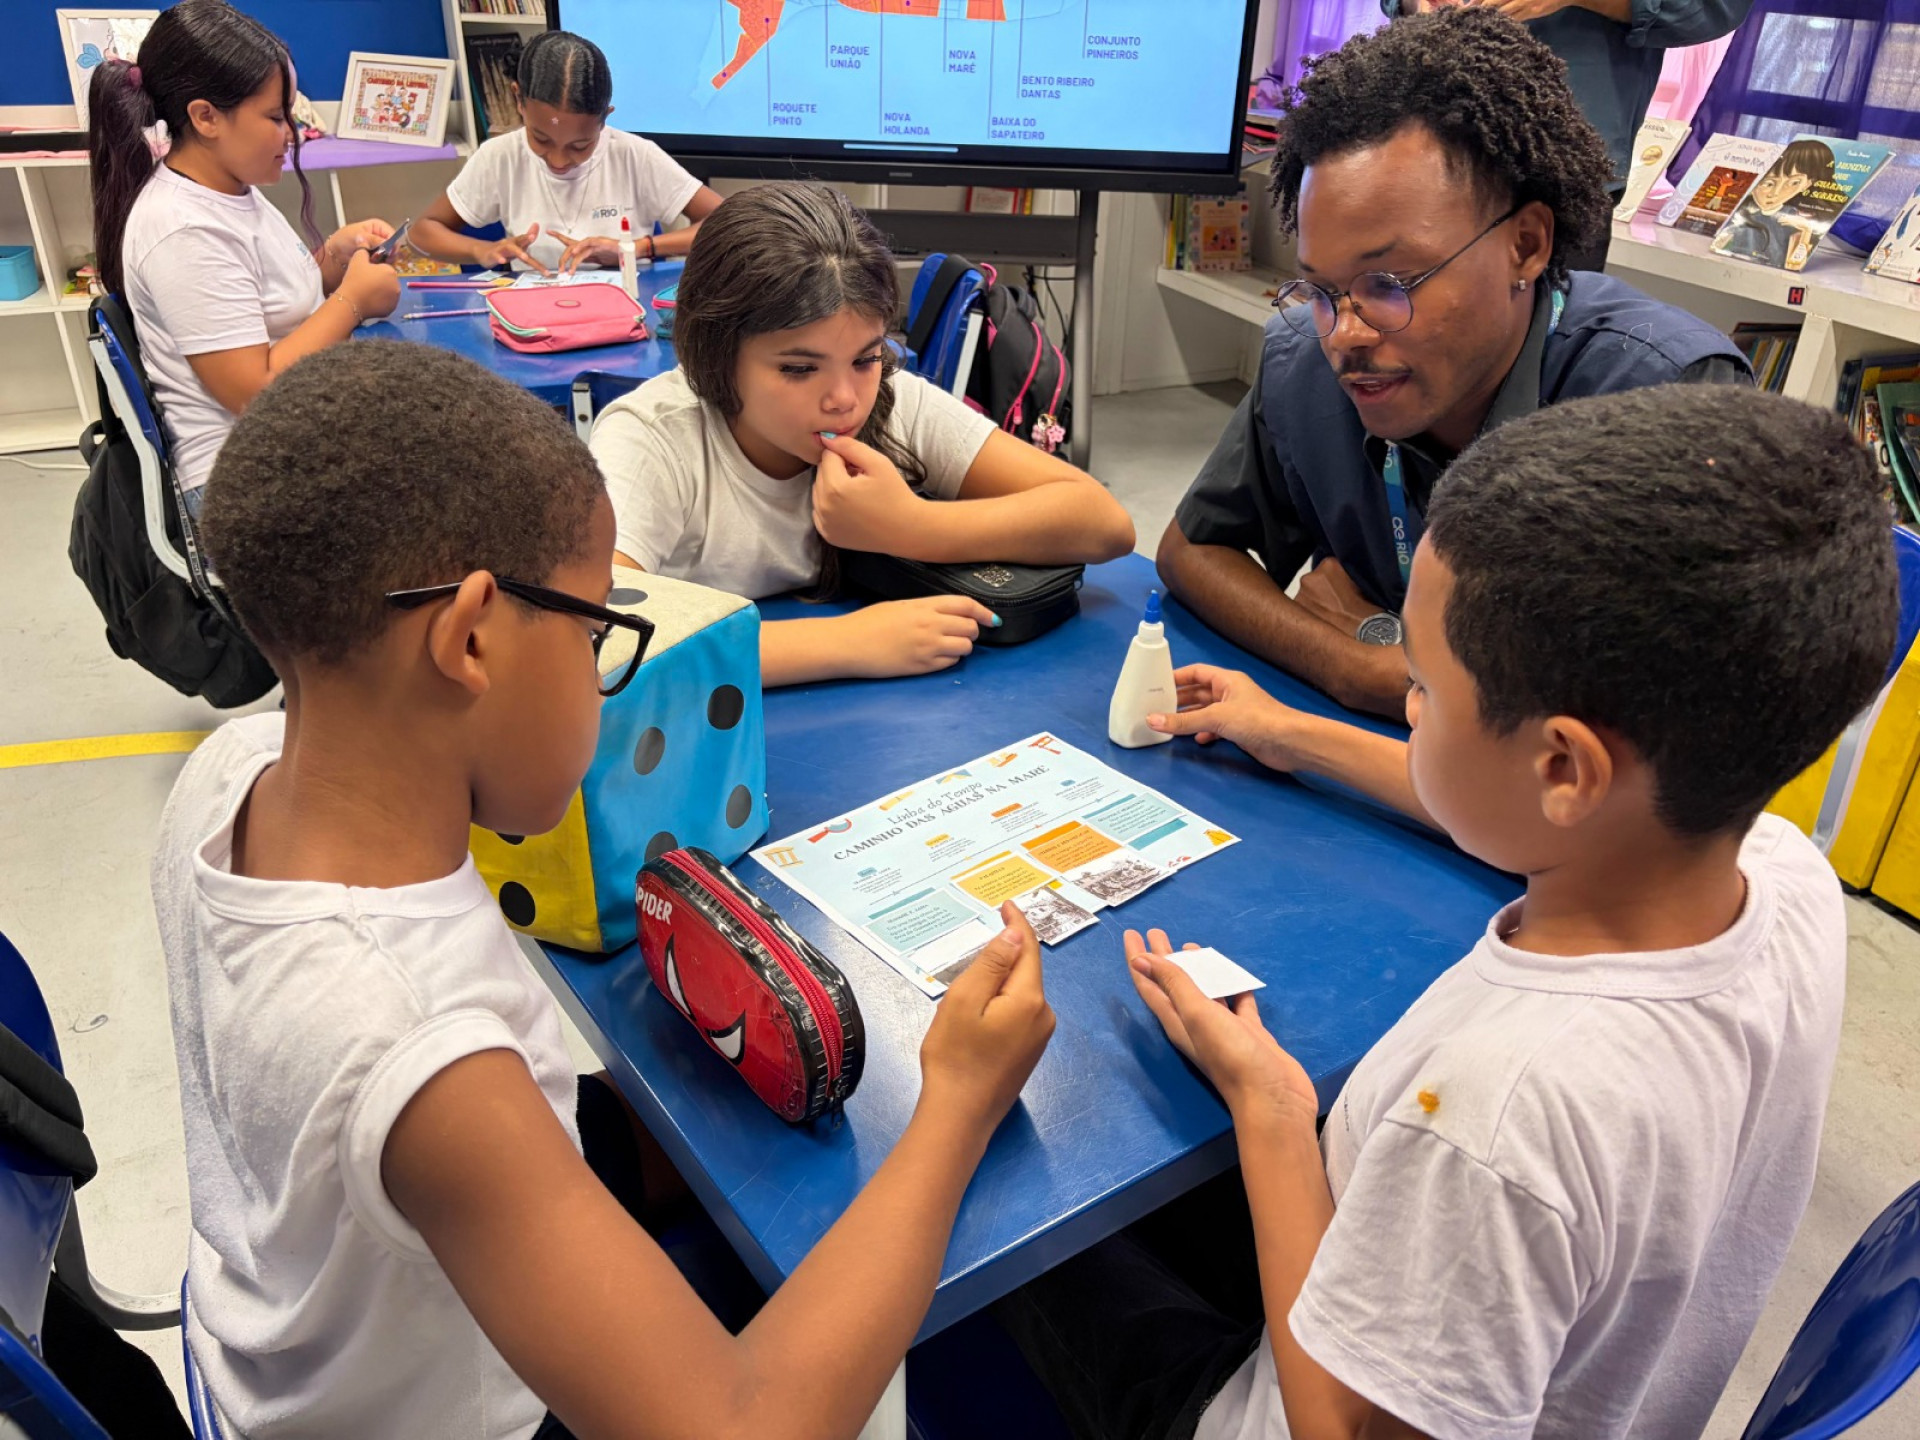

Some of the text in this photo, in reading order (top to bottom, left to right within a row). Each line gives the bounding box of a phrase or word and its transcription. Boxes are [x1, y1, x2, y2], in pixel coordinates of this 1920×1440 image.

[1087, 35, 1141, 47] CONJUNTO
[830, 44, 870, 56] PARQUE
[948, 50, 976, 60] NOVA
[1086, 49, 1139, 60] PINHEIROS
[830, 58, 861, 69] UNIÃO
[948, 62, 976, 73] MARÉ
[1022, 75, 1095, 87] BENTO RIBEIRO
[1021, 88, 1061, 99] DANTAS
[772, 102, 817, 114] ROQUETE
[772, 115, 802, 126] PINTO
[884, 112, 911, 122] NOVA
[991, 116, 1036, 127] BAIXA DO
[884, 125, 930, 136] HOLANDA
[991, 130, 1045, 140] SAPATEIRO
[1791, 288, 1803, 303] H
[1395, 542, 1410, 565] RIO
[927, 797, 943, 810] do
[941, 781, 983, 801] Tempo
[833, 826, 904, 860] CAMINHO
[904, 813, 937, 829] DAS
[984, 783, 1008, 795] NA
